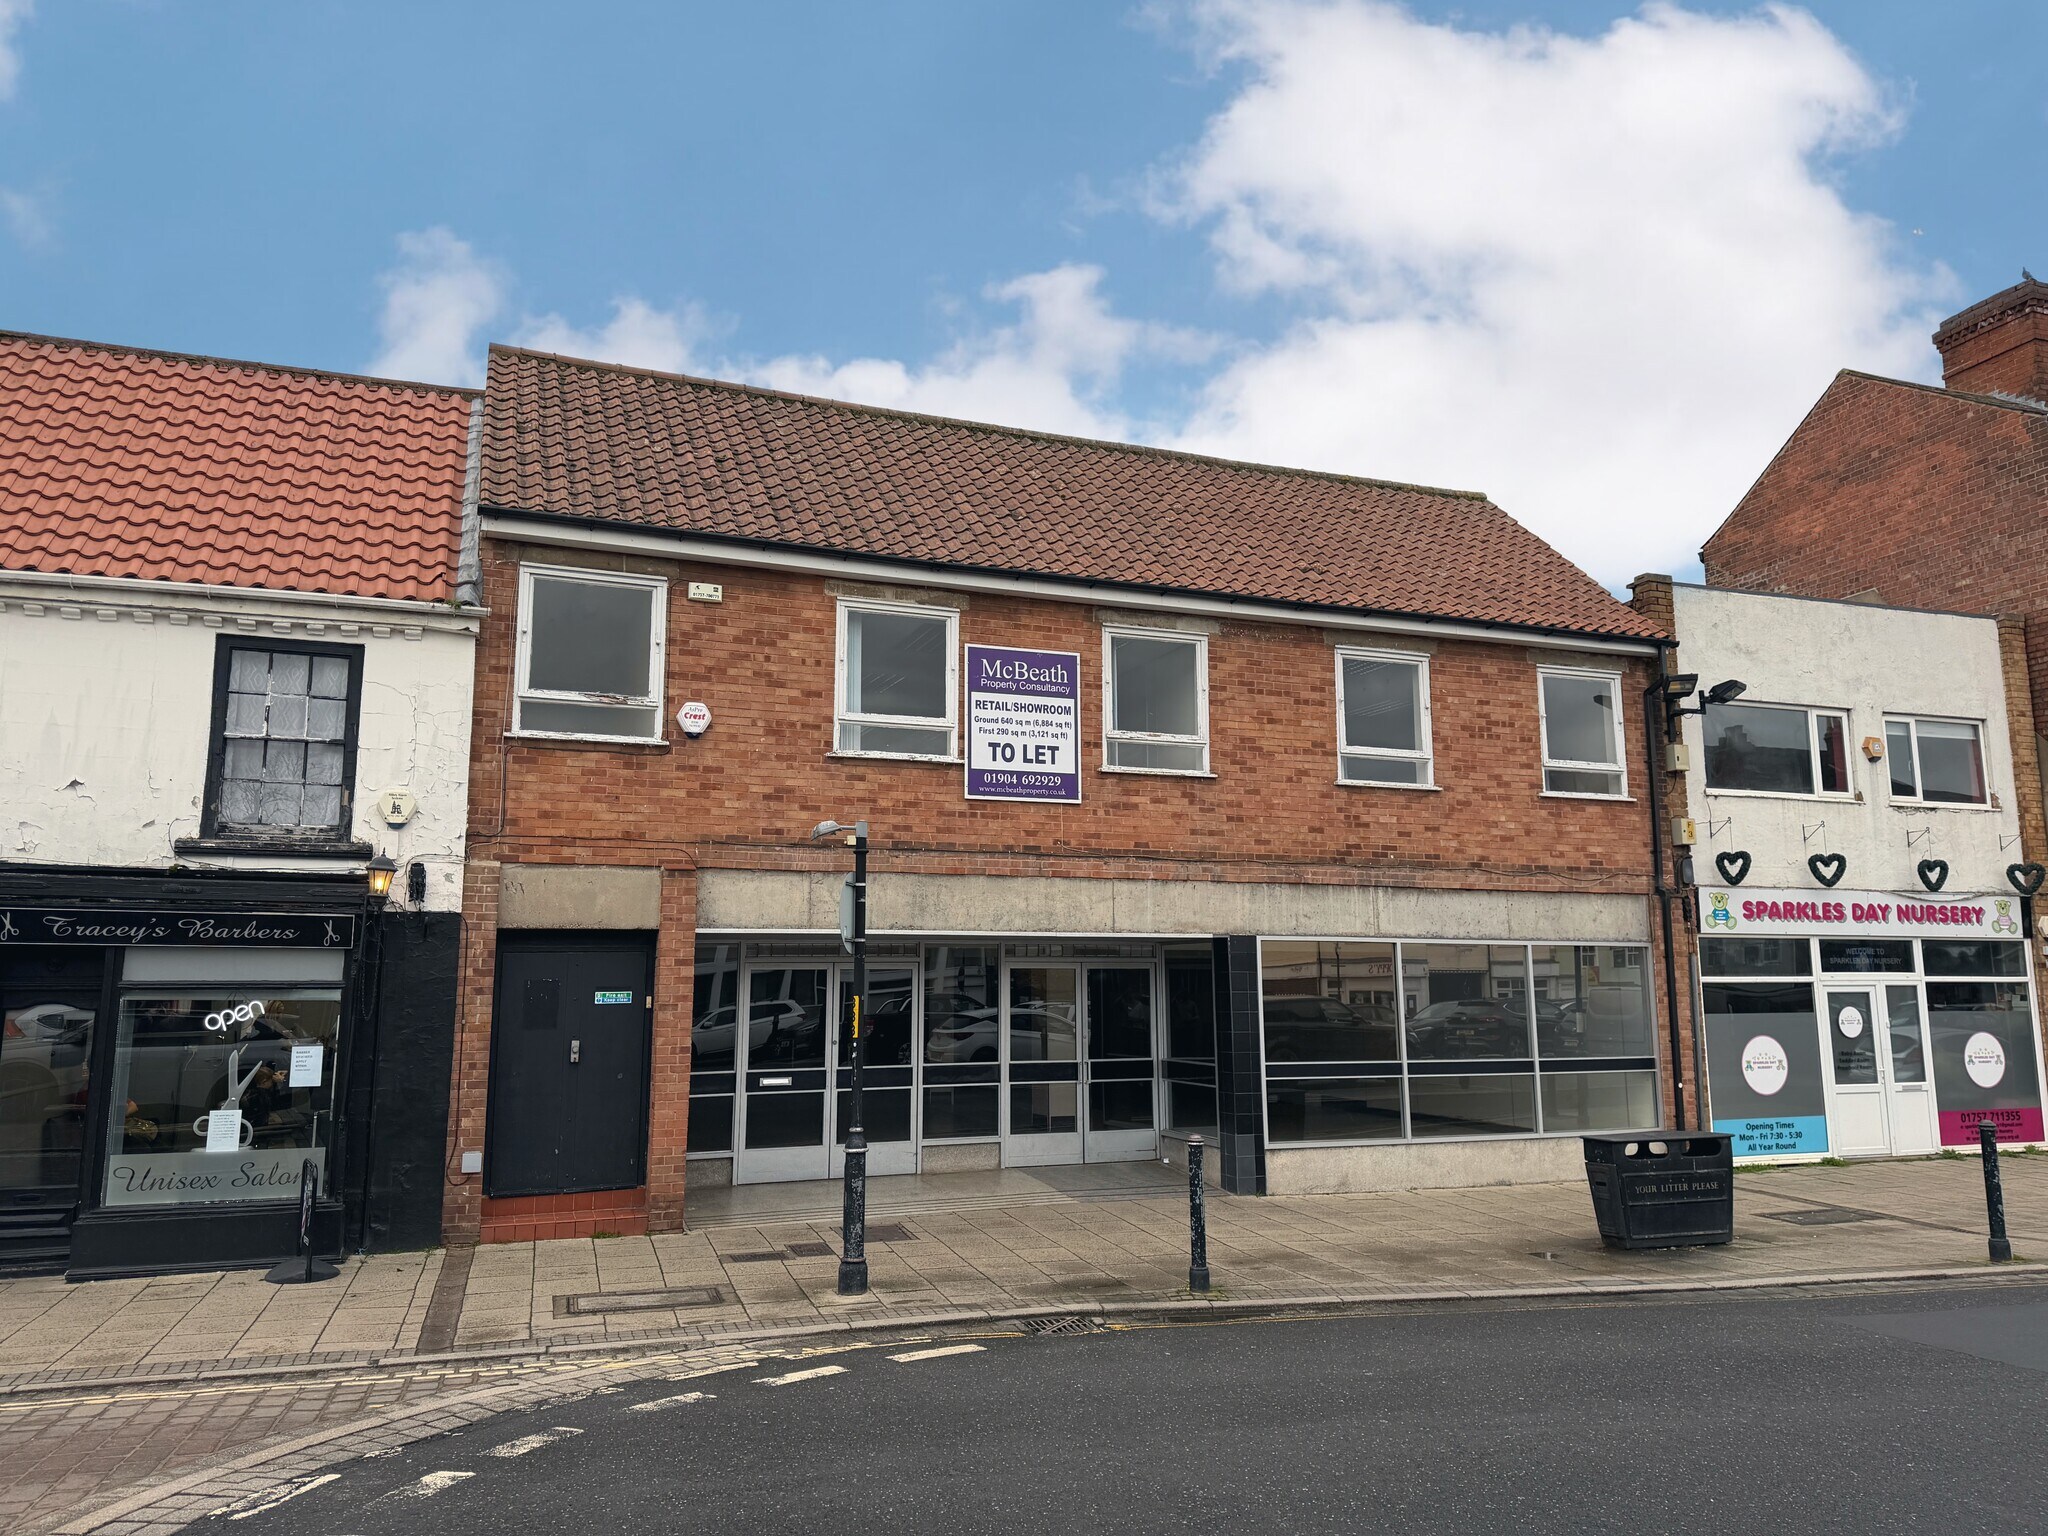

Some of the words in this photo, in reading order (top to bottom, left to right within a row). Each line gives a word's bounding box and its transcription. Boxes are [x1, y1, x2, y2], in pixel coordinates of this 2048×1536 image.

[981, 658, 1068, 683] McBeath
[981, 678, 1017, 691] Property
[1020, 681, 1070, 695] Consultancy
[975, 700, 1072, 715] RETAIL/SHOWROOM
[684, 712, 706, 720] Crest
[974, 716, 999, 724] Ground
[1001, 717, 1013, 725] 640
[1033, 719, 1053, 728] (6,884
[1055, 721, 1062, 729] sq
[1064, 721, 1072, 730] ft)
[979, 727, 994, 735] First
[996, 728, 1009, 736] 290
[1028, 729, 1049, 738] (3,121
[1051, 732, 1058, 740] sq
[1060, 732, 1068, 740] ft)
[988, 742, 1015, 763] TO
[1023, 744, 1059, 765] LET
[984, 773, 1017, 784] 01904
[1021, 774, 1061, 786] 692929
[979, 786, 1066, 796] www.mcbeathproperty.co.uk
[1742, 900, 1847, 923] SPARKLES
[1852, 903, 1891, 924] DAY
[1897, 904, 1985, 926] NURSERY
[43, 916, 171, 943] Tracey's
[178, 919, 301, 940] Barbers
[1874, 957, 1902, 965] NURSERY
[205, 1001, 265, 1031] open
[1961, 1112, 1988, 1122] 01757
[1990, 1111, 2021, 1122] 711355
[1746, 1122, 1774, 1131] Opening
[1770, 1132, 1783, 1140] 7:30
[1789, 1131, 1802, 1139] 5:30
[1758, 1143, 1774, 1151] Year
[1775, 1142, 1796, 1150] Round
[113, 1167, 223, 1192] Unisex
[1635, 1185, 1657, 1194] YOUR
[1661, 1184, 1688, 1193] LITTER
[1692, 1182, 1719, 1191] PLEASE
